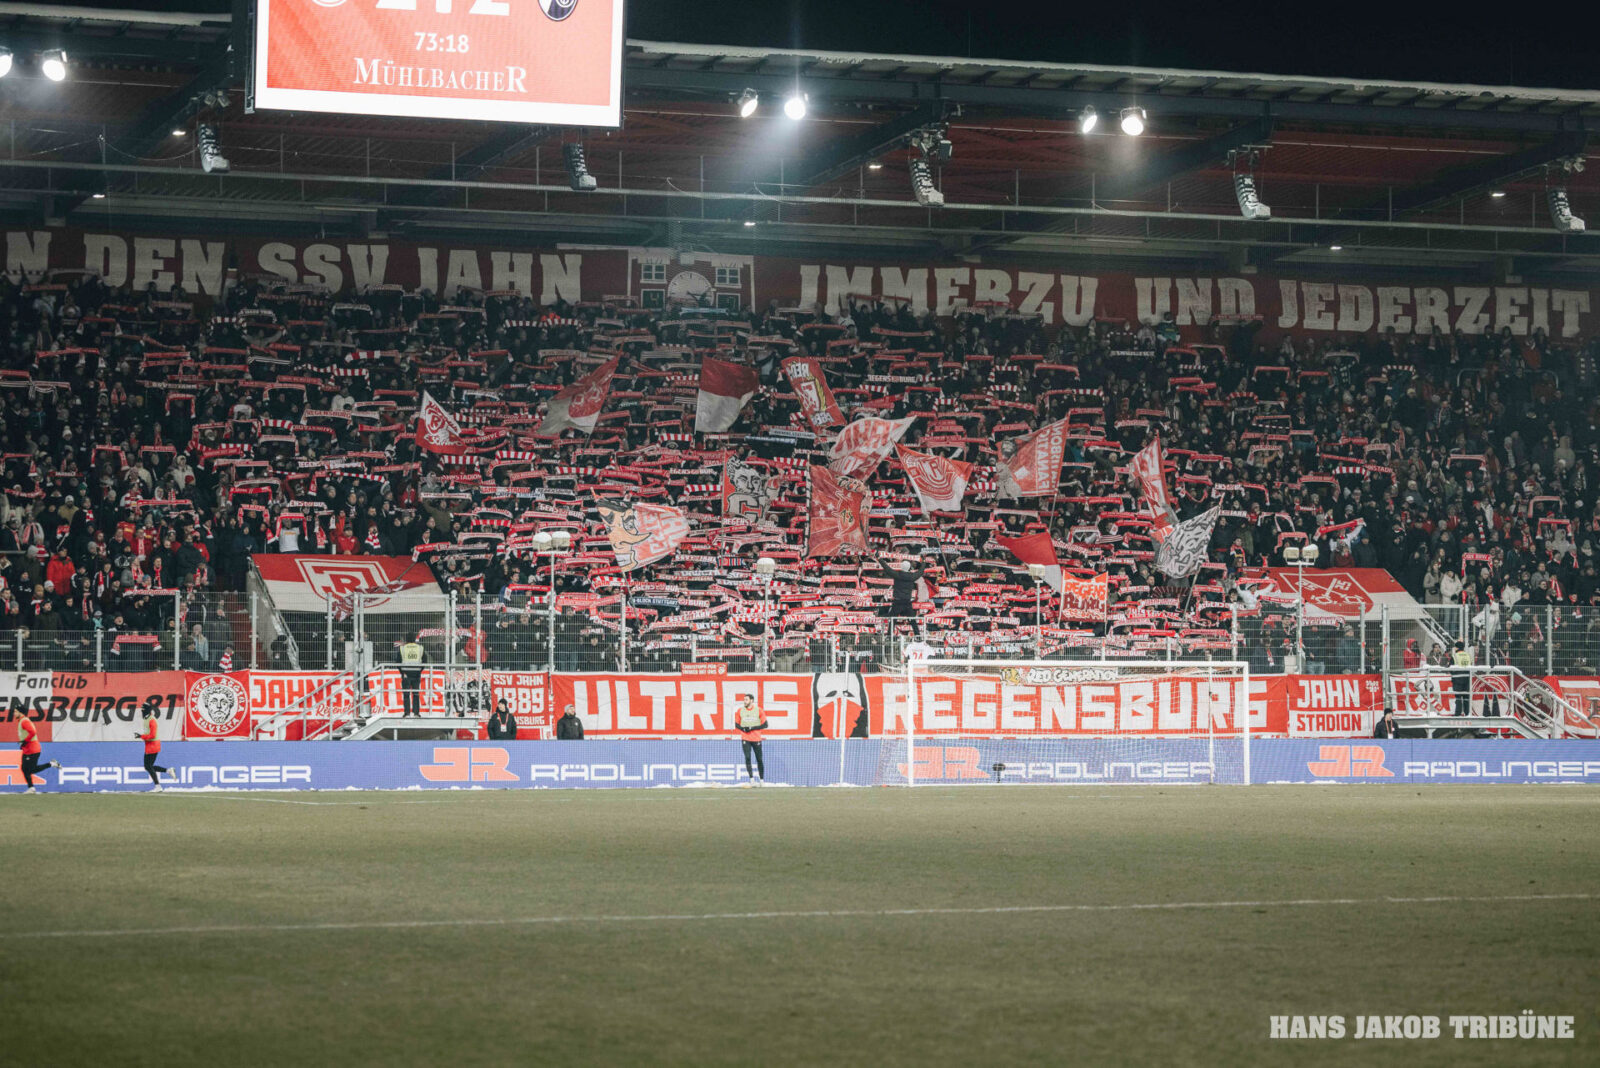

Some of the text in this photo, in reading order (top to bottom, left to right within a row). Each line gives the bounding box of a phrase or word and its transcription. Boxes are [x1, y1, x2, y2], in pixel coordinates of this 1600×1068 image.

[413, 31, 470, 54] 73:18
[352, 57, 529, 94] MÜHLBACHER
[84, 233, 225, 296] DEN
[258, 242, 389, 295] SSV
[417, 247, 582, 305] JAHN
[800, 264, 1098, 327] IMMERZU
[1134, 277, 1256, 327] UND
[1277, 279, 1591, 339] JEDERZEIT
[16, 673, 88, 690] Fanclub
[492, 674, 544, 687] SSV JAHN
[1298, 678, 1361, 709] JAHN
[493, 687, 545, 714] 1889
[573, 680, 799, 731] ULTRAS
[881, 679, 1268, 731] REGENSBURG
[1299, 713, 1362, 732] STADION
